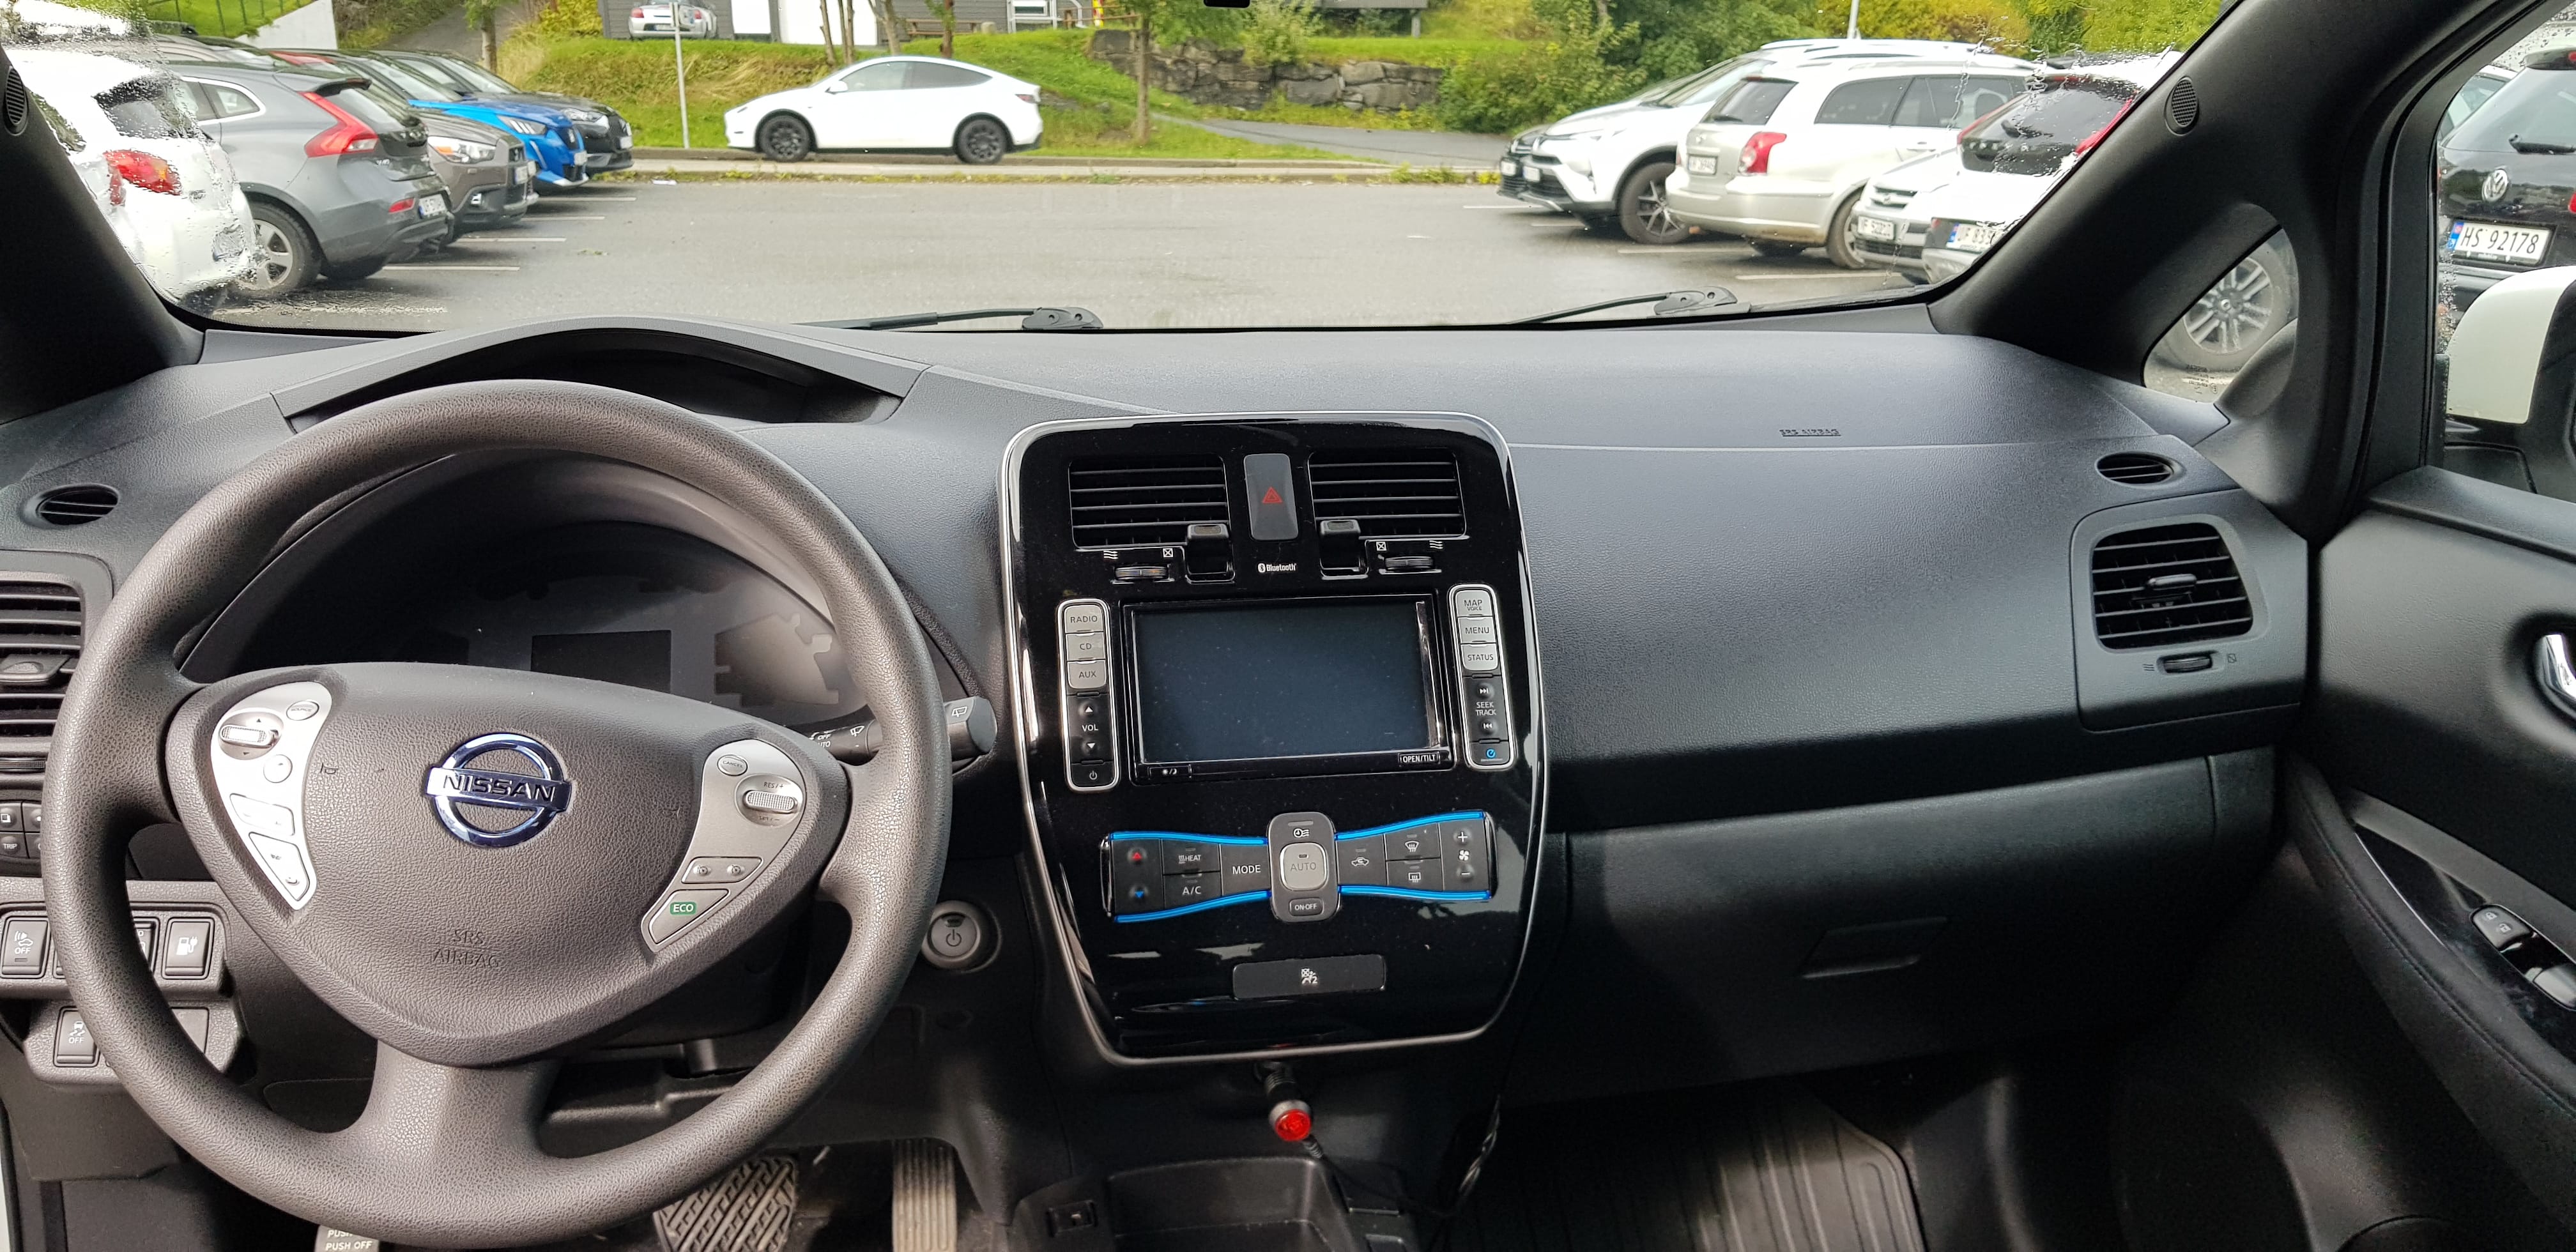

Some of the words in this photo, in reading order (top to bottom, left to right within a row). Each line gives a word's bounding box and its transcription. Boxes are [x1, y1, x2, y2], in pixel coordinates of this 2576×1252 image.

[2460, 227, 2484, 248] HS
[2487, 230, 2540, 254] 92178
[1070, 615, 1098, 623] RADIO
[1464, 626, 1490, 634] MENU
[1078, 670, 1097, 678] AUX
[1081, 723, 1099, 732] VOL
[1402, 754, 1436, 763] OPEN/TILT
[443, 774, 556, 802] NISSAN
[1231, 864, 1261, 874] MODE
[1291, 862, 1317, 871] AUTO
[1182, 885, 1201, 896] A/C
[673, 903, 694, 913] ECO
[452, 929, 484, 944] SRS
[14, 947, 31, 955] OFF
[433, 949, 500, 968] AIRBAG
[325, 1241, 351, 1251] PUSH
[353, 1240, 373, 1249] OFF
